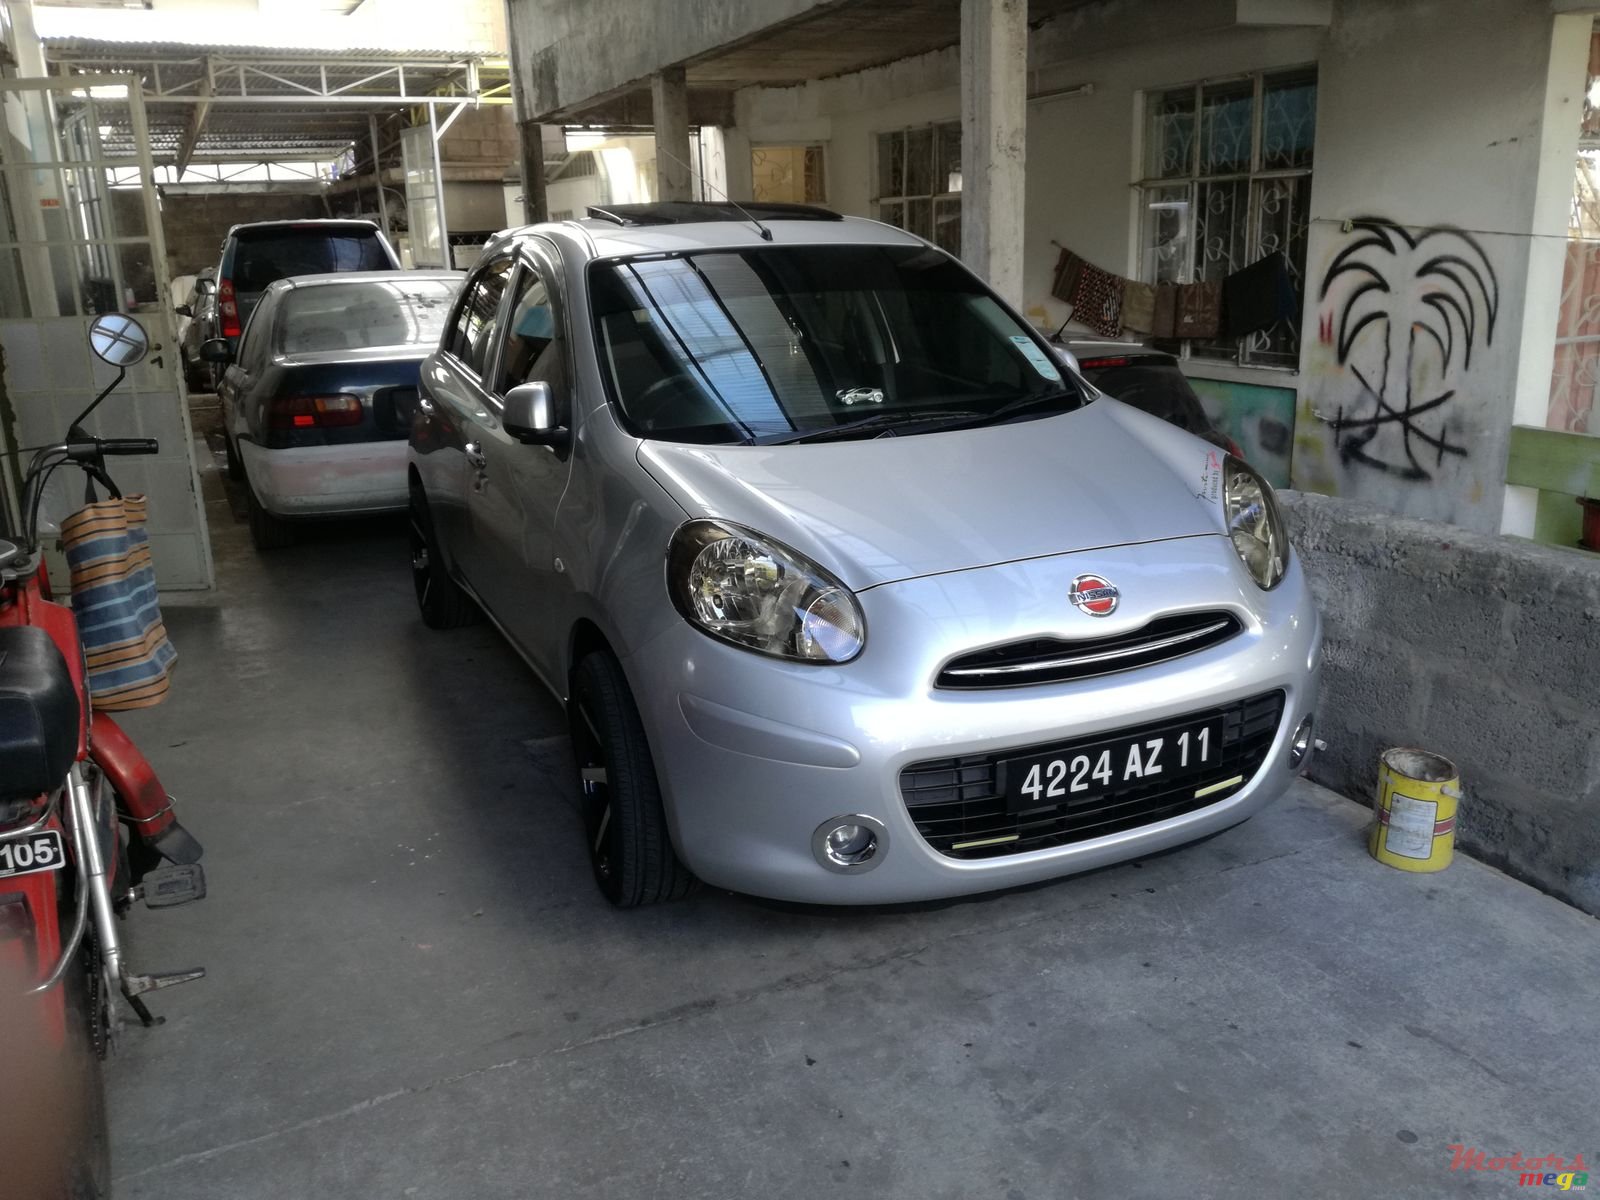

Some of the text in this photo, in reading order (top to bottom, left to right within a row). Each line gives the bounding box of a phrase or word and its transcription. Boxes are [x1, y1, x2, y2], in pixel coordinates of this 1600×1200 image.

[1021, 727, 1209, 800] 4224 AZ 11
[0, 838, 54, 869] 105
